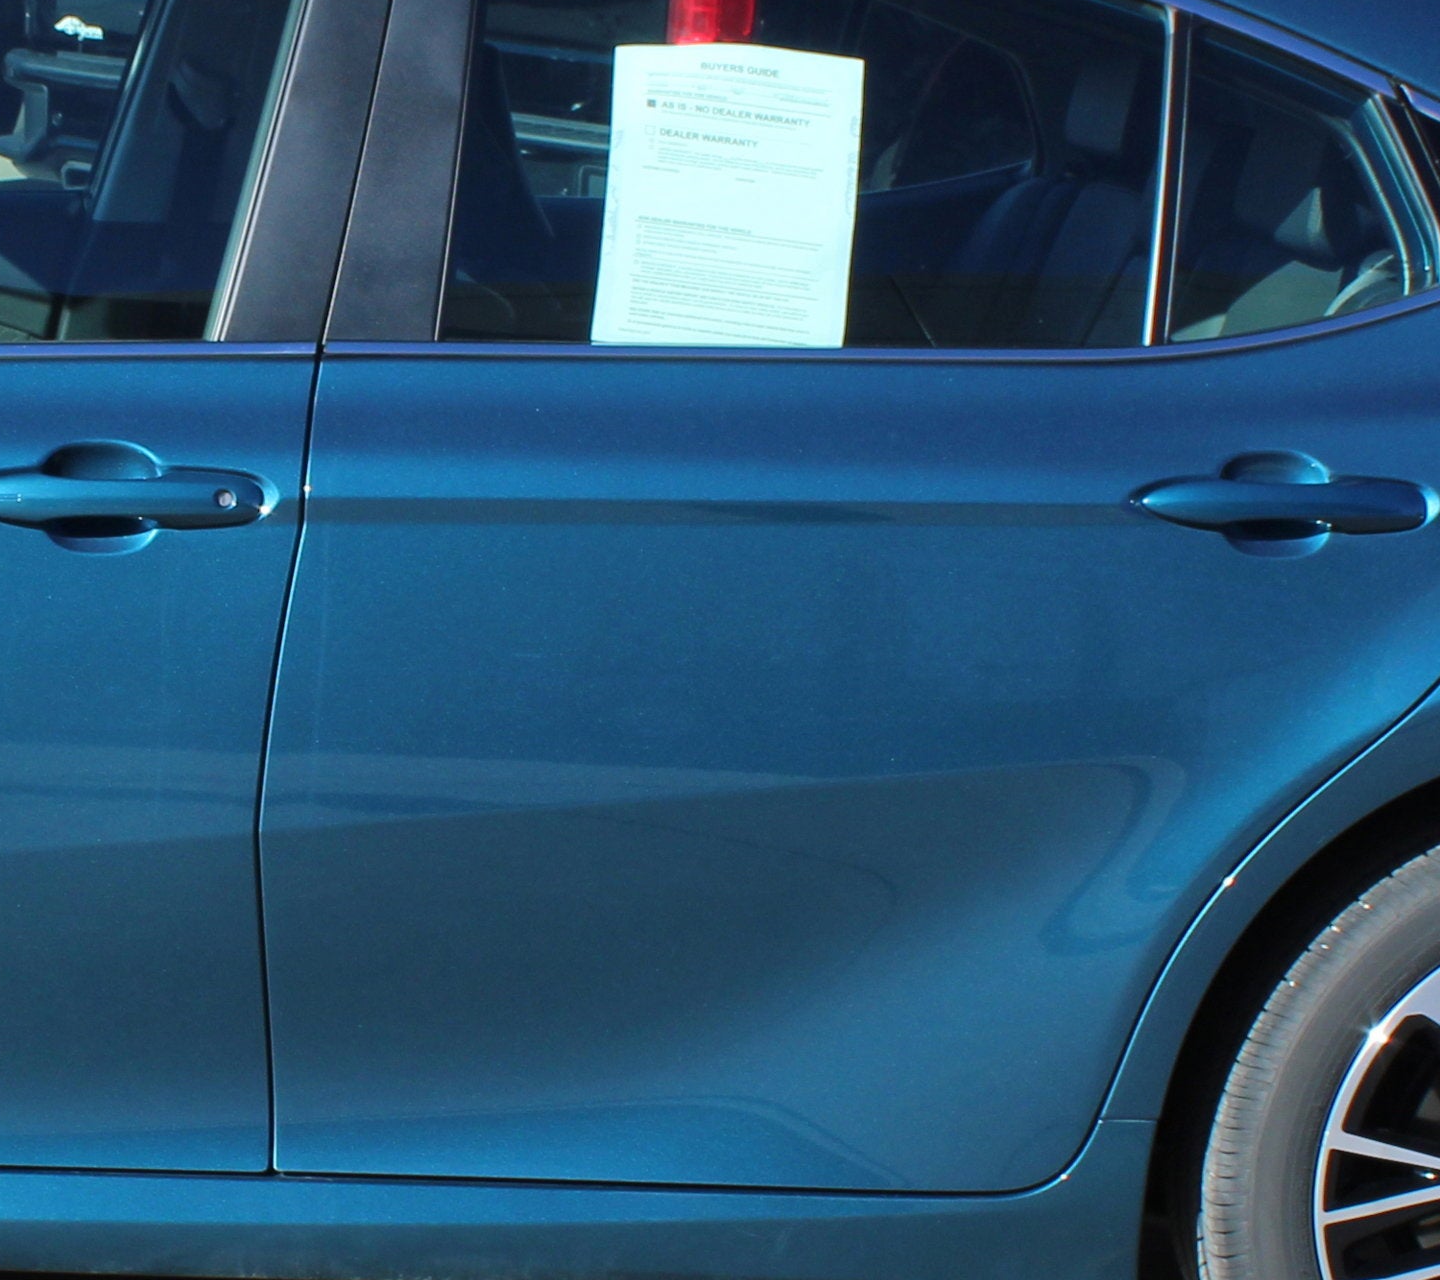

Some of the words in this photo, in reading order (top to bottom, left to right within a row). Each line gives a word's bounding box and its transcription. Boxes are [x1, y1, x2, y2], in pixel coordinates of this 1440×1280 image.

[700, 62, 744, 73] BUYERS
[747, 66, 779, 79] GUIDE
[695, 105, 710, 114] NO
[712, 107, 752, 120] DEALER
[754, 112, 811, 127] WARRANTY
[659, 128, 699, 141] DEALER
[701, 133, 759, 148] WARRANTY
